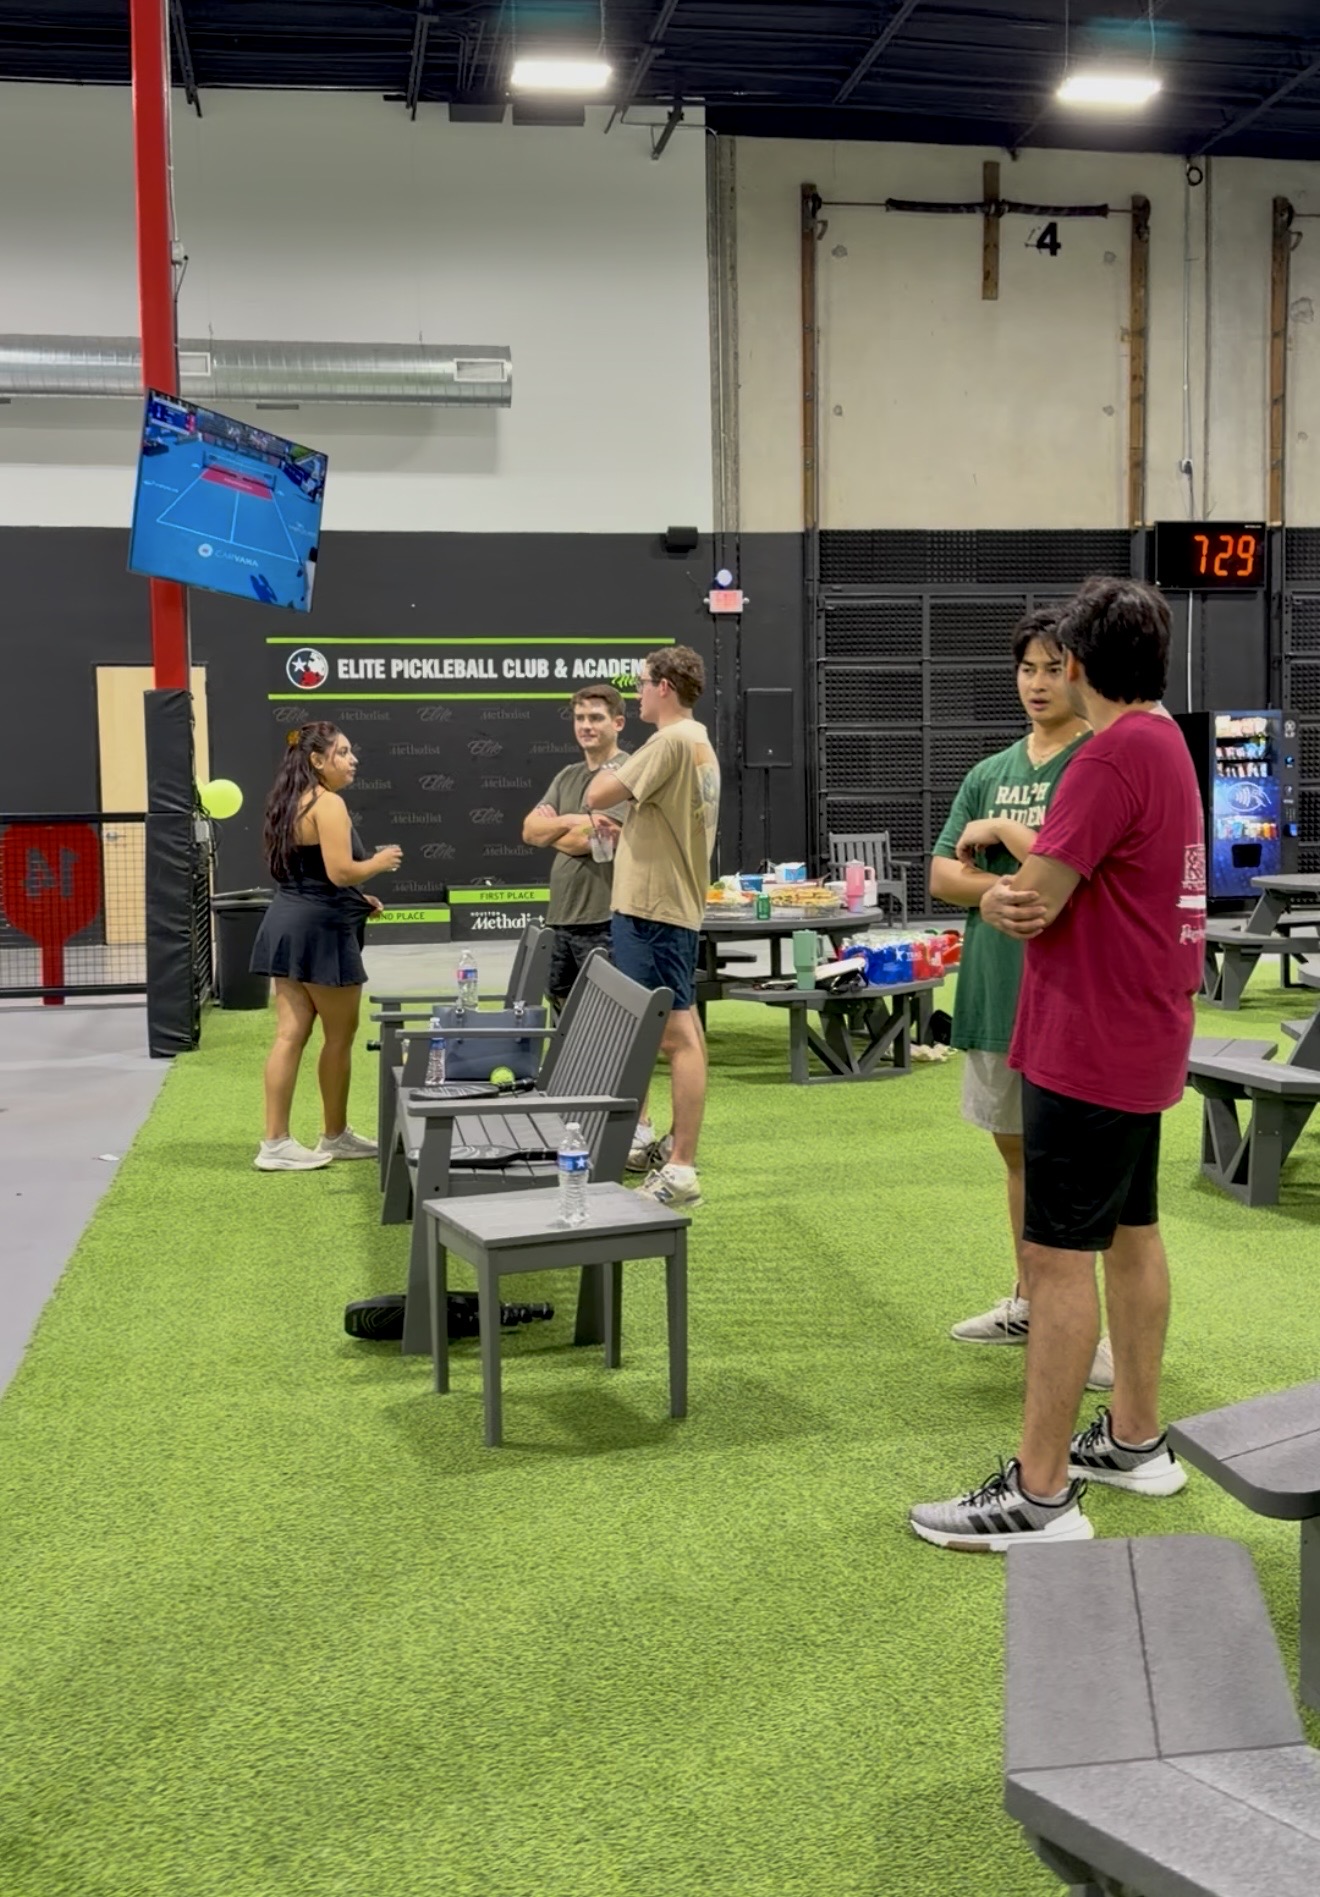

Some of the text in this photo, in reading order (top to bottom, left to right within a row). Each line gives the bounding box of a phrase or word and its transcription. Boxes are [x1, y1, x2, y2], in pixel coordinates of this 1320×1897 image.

[1036, 221, 1062, 257] 4
[338, 657, 645, 679] ELITE PICKLEBALL CLUB & ACADEM
[480, 891, 535, 900] FIRST PLACE
[397, 911, 425, 920] PLACE
[471, 912, 546, 930] Methodt
